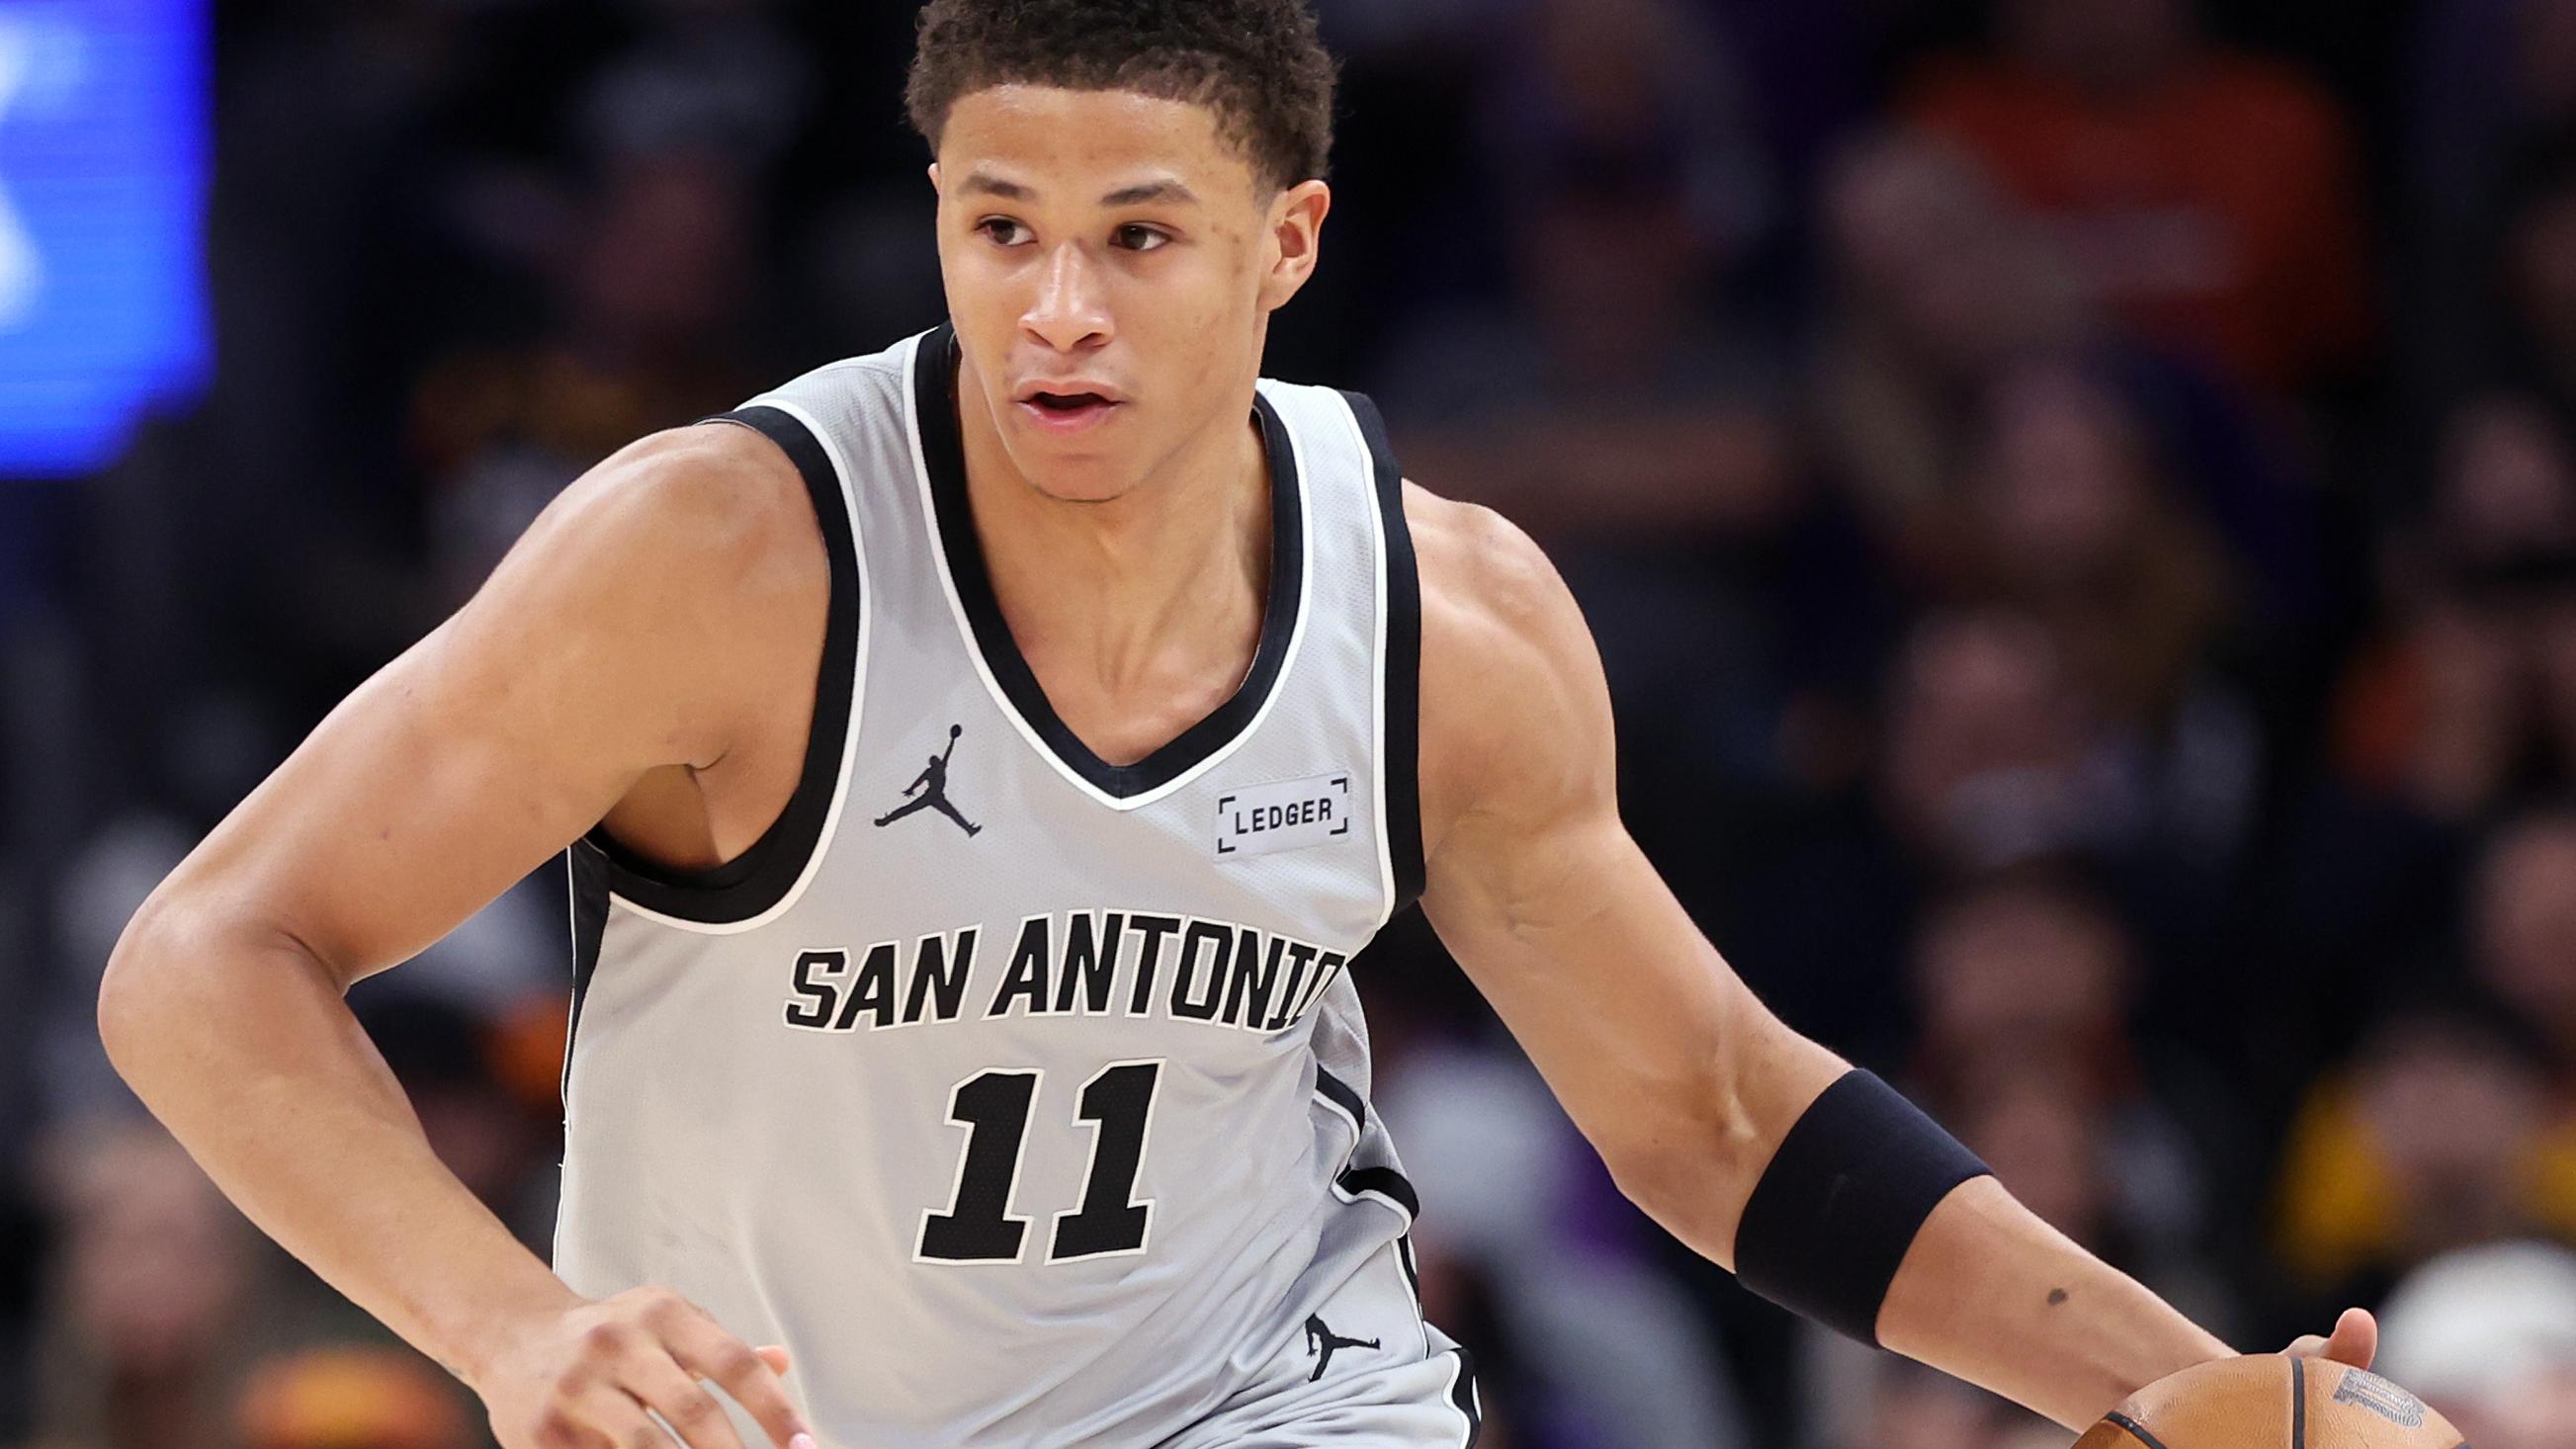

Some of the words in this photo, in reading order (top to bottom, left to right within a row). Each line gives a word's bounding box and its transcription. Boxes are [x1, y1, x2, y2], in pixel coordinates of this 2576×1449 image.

[1236, 798, 1332, 835] LEDGER
[785, 924, 983, 1033] SAN
[983, 908, 1347, 1034] ANTONIO
[912, 1058, 1166, 1265] 11
